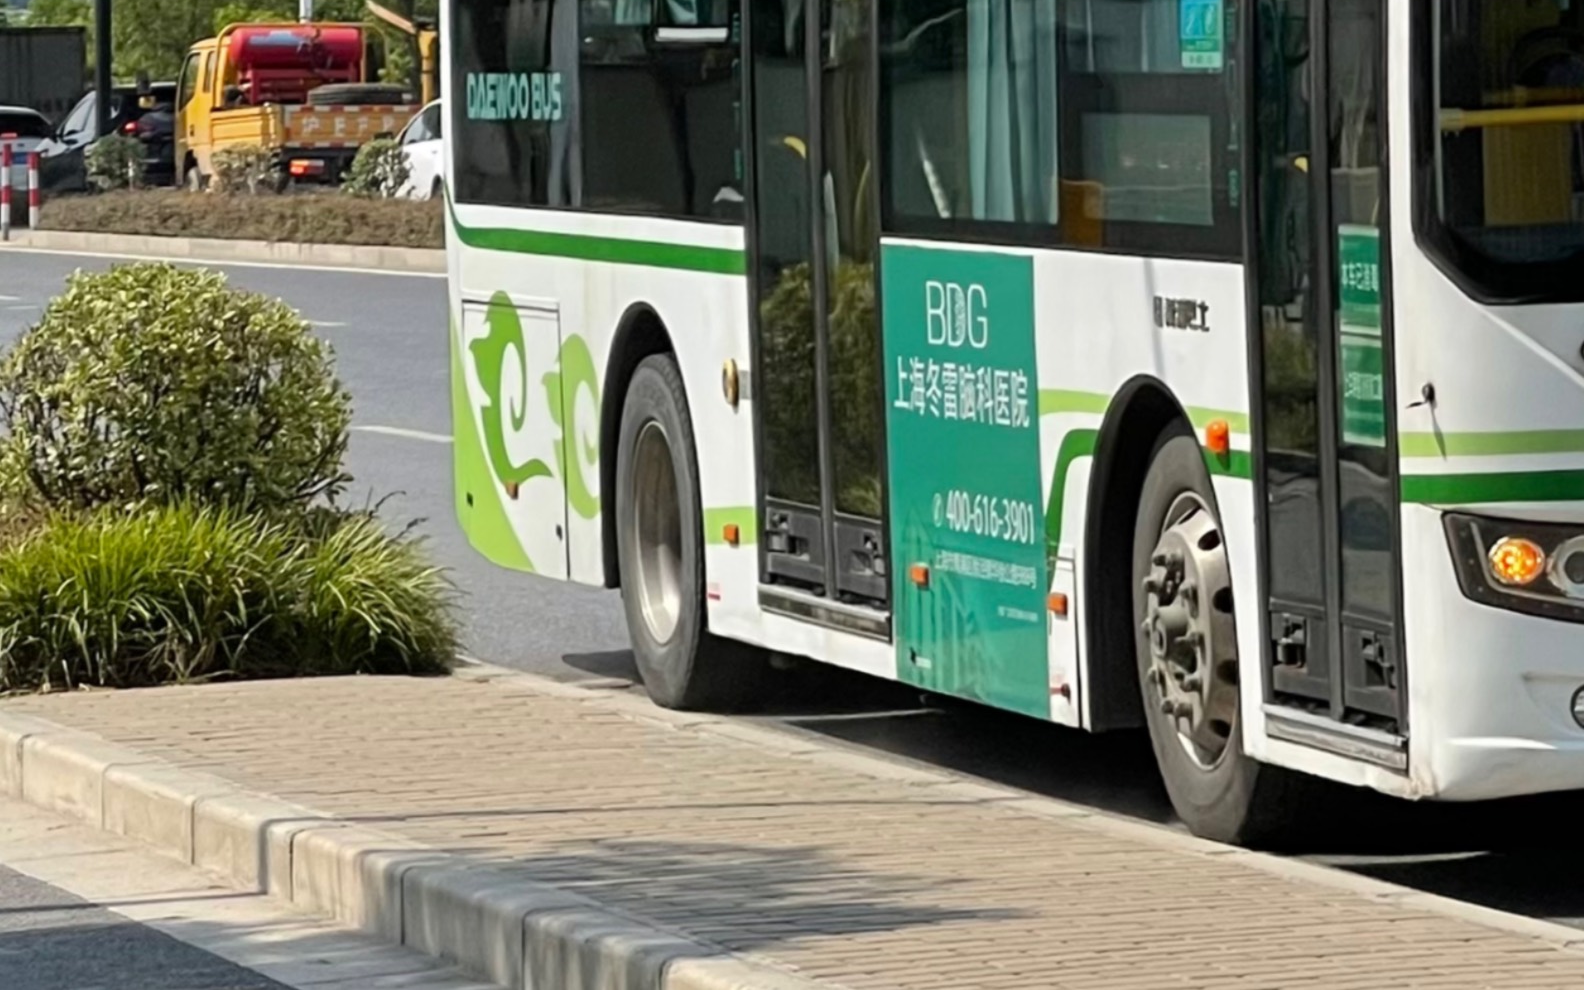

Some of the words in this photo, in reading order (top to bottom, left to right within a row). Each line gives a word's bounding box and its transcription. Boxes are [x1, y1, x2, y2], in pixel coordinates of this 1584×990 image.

[467, 72, 529, 120] DAEWOO
[531, 72, 561, 121] BUS
[926, 281, 988, 348] BDG
[894, 356, 1030, 428] 上海冬雷脑科医院
[946, 490, 1035, 545] 400-616-3901
